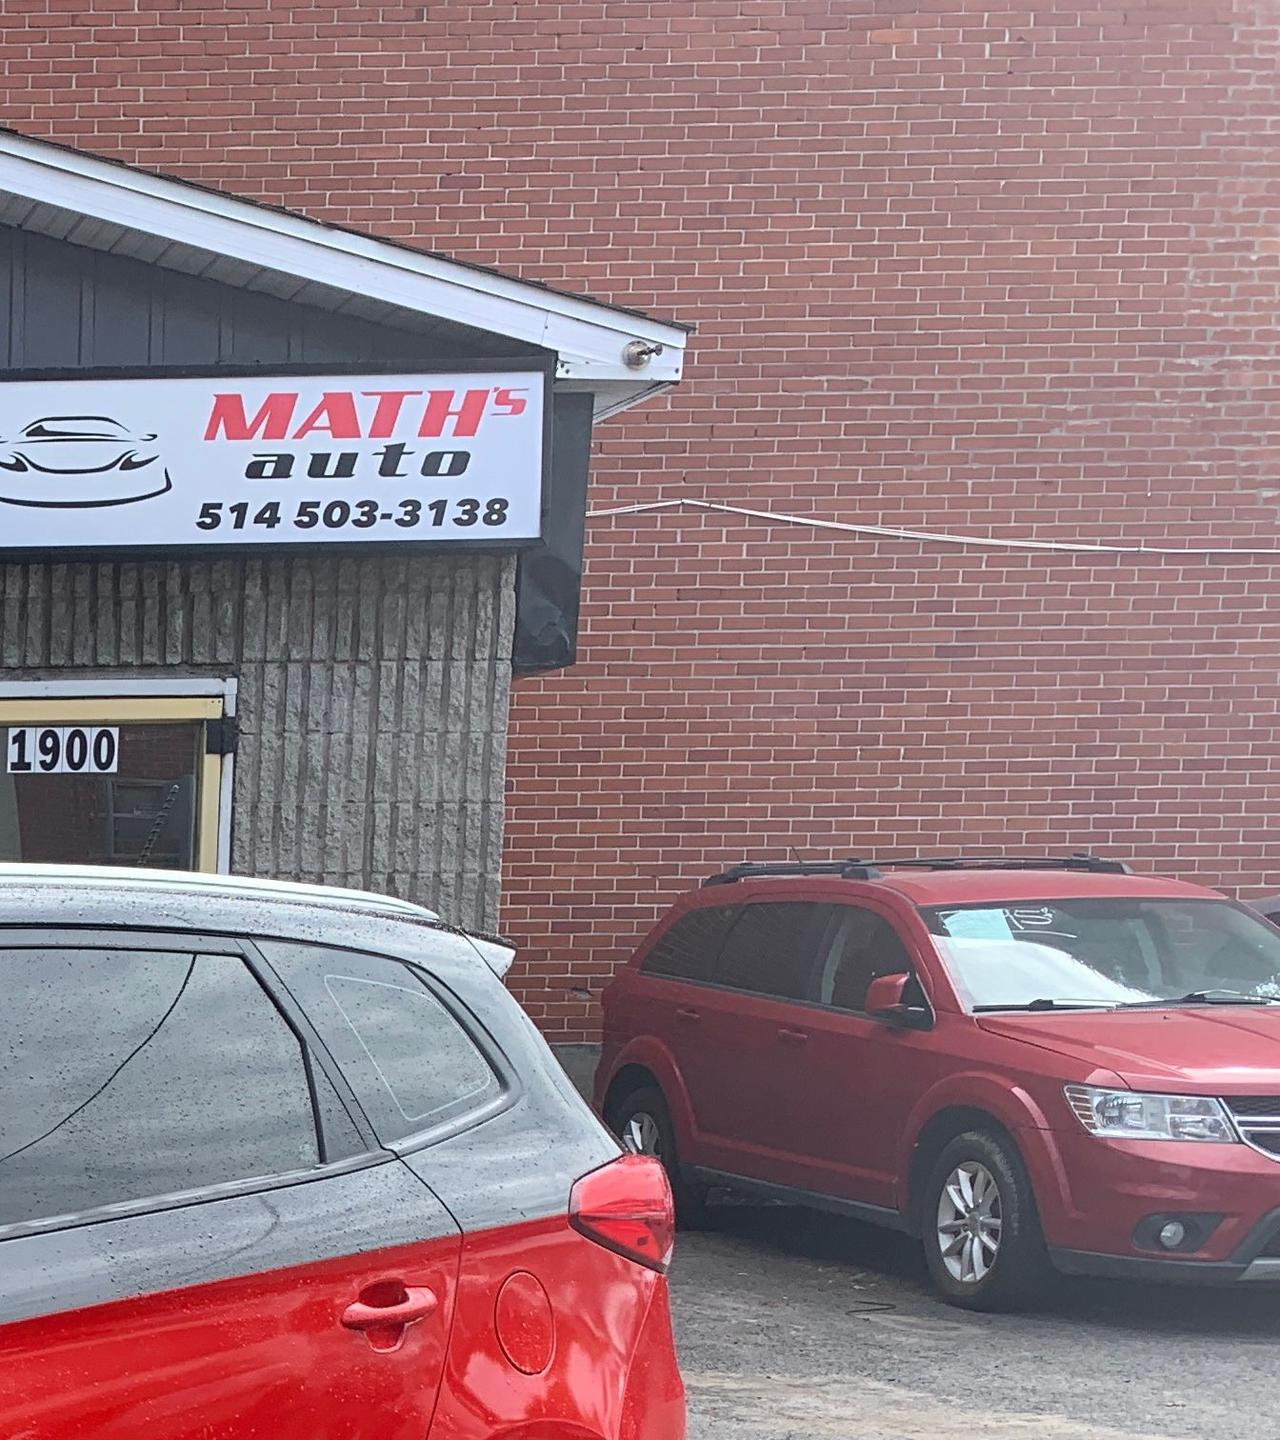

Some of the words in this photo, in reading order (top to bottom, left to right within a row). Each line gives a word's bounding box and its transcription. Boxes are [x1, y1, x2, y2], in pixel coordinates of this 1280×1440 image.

[244, 442, 471, 480] auto
[195, 501, 282, 531] 514
[293, 497, 510, 530] 503-3138
[9, 728, 116, 772] 1900
